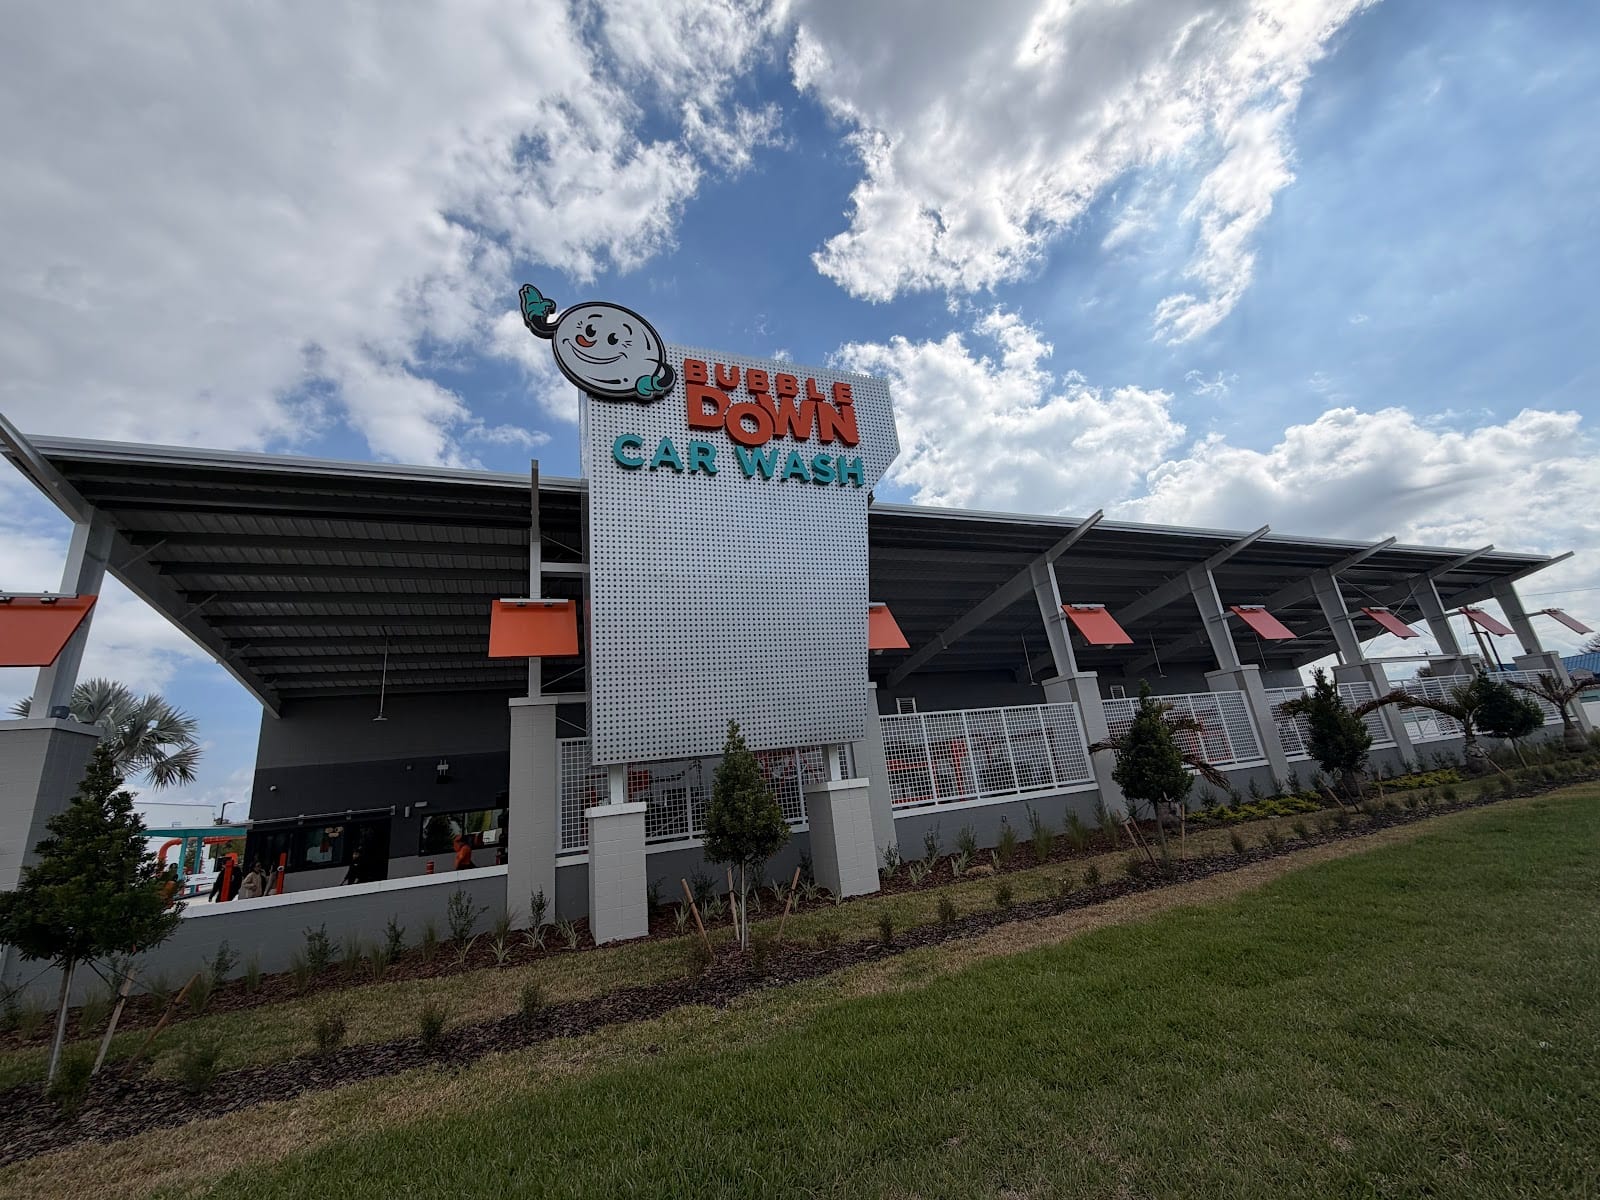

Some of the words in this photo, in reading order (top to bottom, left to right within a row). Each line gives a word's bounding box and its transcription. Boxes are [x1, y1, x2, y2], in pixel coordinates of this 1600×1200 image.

[684, 358, 853, 406] BUBBLE
[685, 382, 859, 446] DOWN
[613, 434, 718, 476] CAR
[734, 446, 864, 487] WASH
